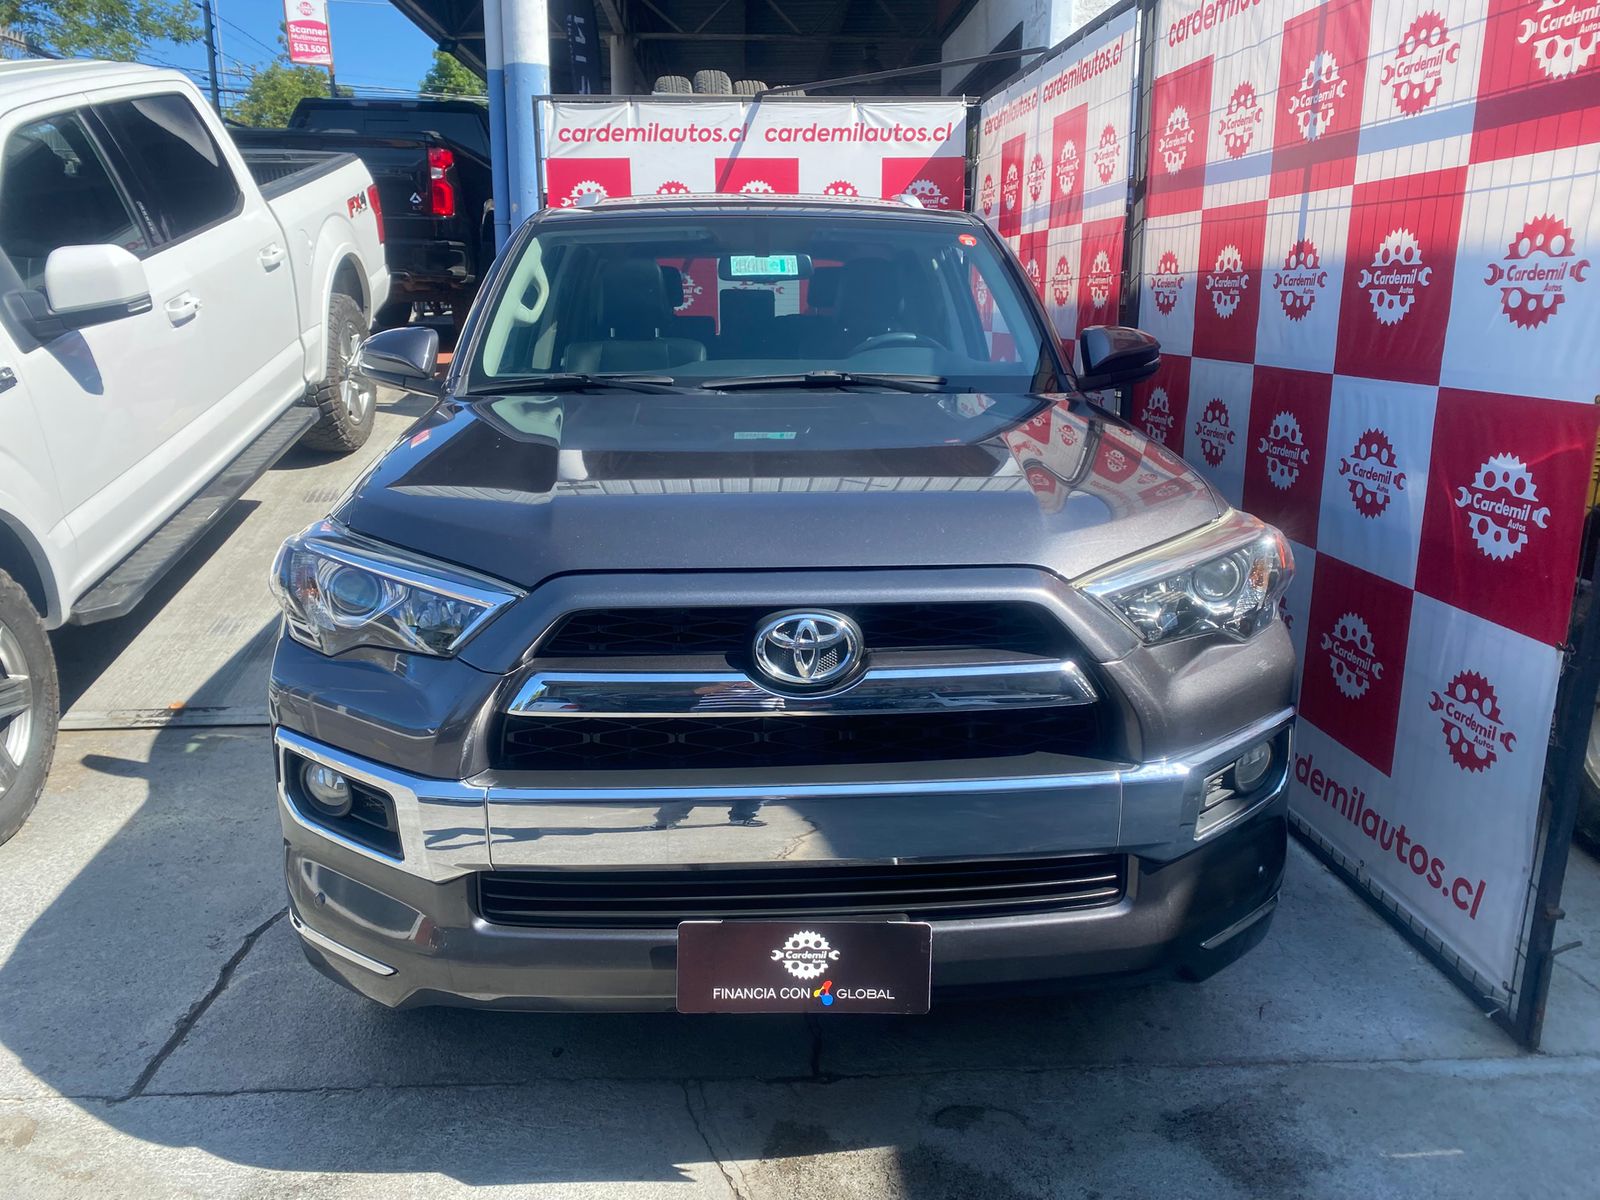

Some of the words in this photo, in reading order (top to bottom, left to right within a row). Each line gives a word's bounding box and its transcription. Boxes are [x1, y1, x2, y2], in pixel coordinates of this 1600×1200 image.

[1540, 5, 1600, 33] Cardemi
[289, 24, 328, 36] Scanner
[293, 42, 328, 54] $53.500
[1043, 33, 1124, 103] cardemilautos.cl
[1396, 47, 1445, 79] Cardemil
[1300, 83, 1337, 109] Cardemil
[1226, 111, 1256, 129] Cardemil
[558, 122, 749, 143] cardemilautos.cl
[764, 122, 953, 143] cardemilautos.cl
[347, 191, 367, 218] FX4
[1282, 272, 1317, 287] Cardemil
[1373, 267, 1418, 285] Cardemil
[1507, 261, 1569, 282] Cardemil
[1214, 275, 1241, 288] Cardemil
[1543, 282, 1563, 292] Autos
[1202, 424, 1227, 441] Cardemil
[1268, 442, 1301, 460] Cardemil
[1352, 462, 1393, 485] Cardemil
[1472, 493, 1532, 522] Cardemil
[1507, 519, 1527, 532] Autos
[1333, 640, 1372, 672] Cardemil
[1445, 702, 1498, 741] Cardemil
[1473, 735, 1495, 751] Autos
[1295, 752, 1487, 921] demilautos.cl
[785, 950, 828, 960] Cardemil
[713, 987, 777, 1000] FINANCIA
[779, 987, 811, 1000] CON
[836, 988, 896, 1000] GLOBAL
